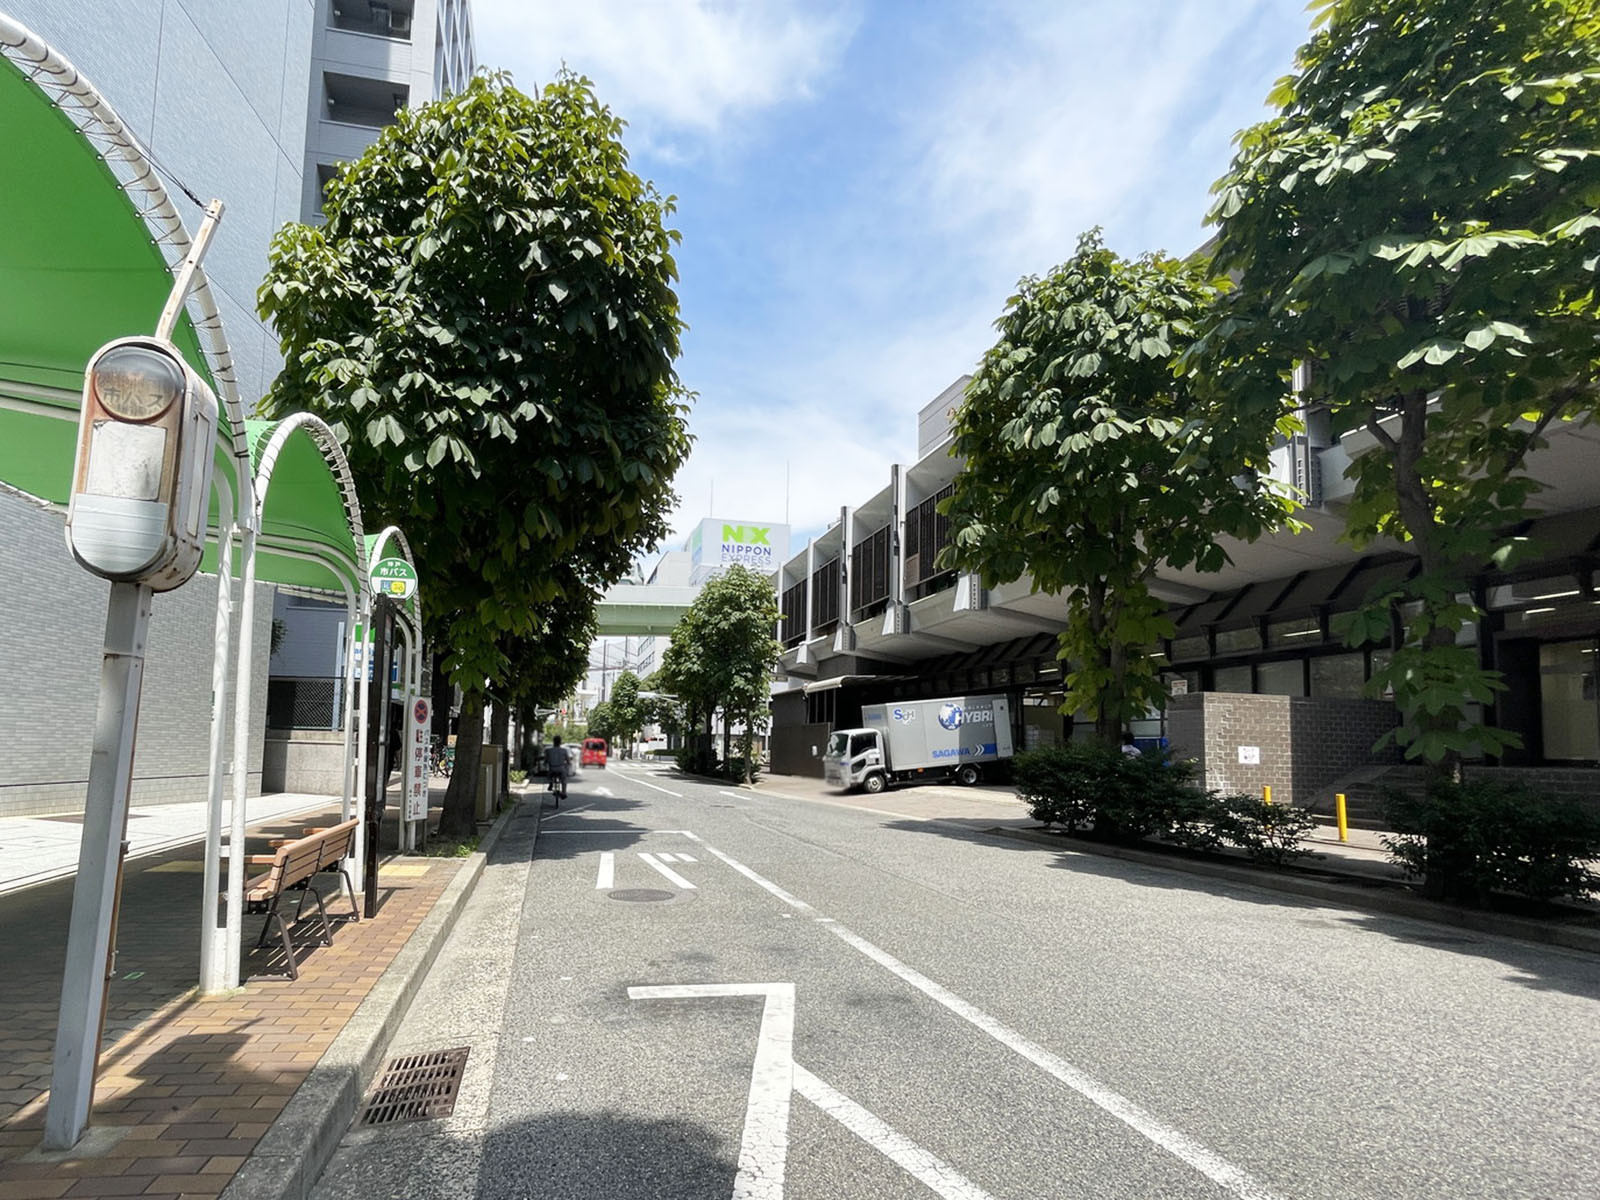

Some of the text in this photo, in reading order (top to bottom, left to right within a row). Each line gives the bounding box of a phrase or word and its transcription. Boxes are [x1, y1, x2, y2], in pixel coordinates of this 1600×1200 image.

[722, 524, 771, 545] NX
[721, 544, 772, 556] NIPPON
[721, 553, 772, 565] EXPRESS
[380, 567, 408, 577] 市バス
[954, 710, 993, 724] HYBRI
[932, 747, 971, 758] SAGAWA
